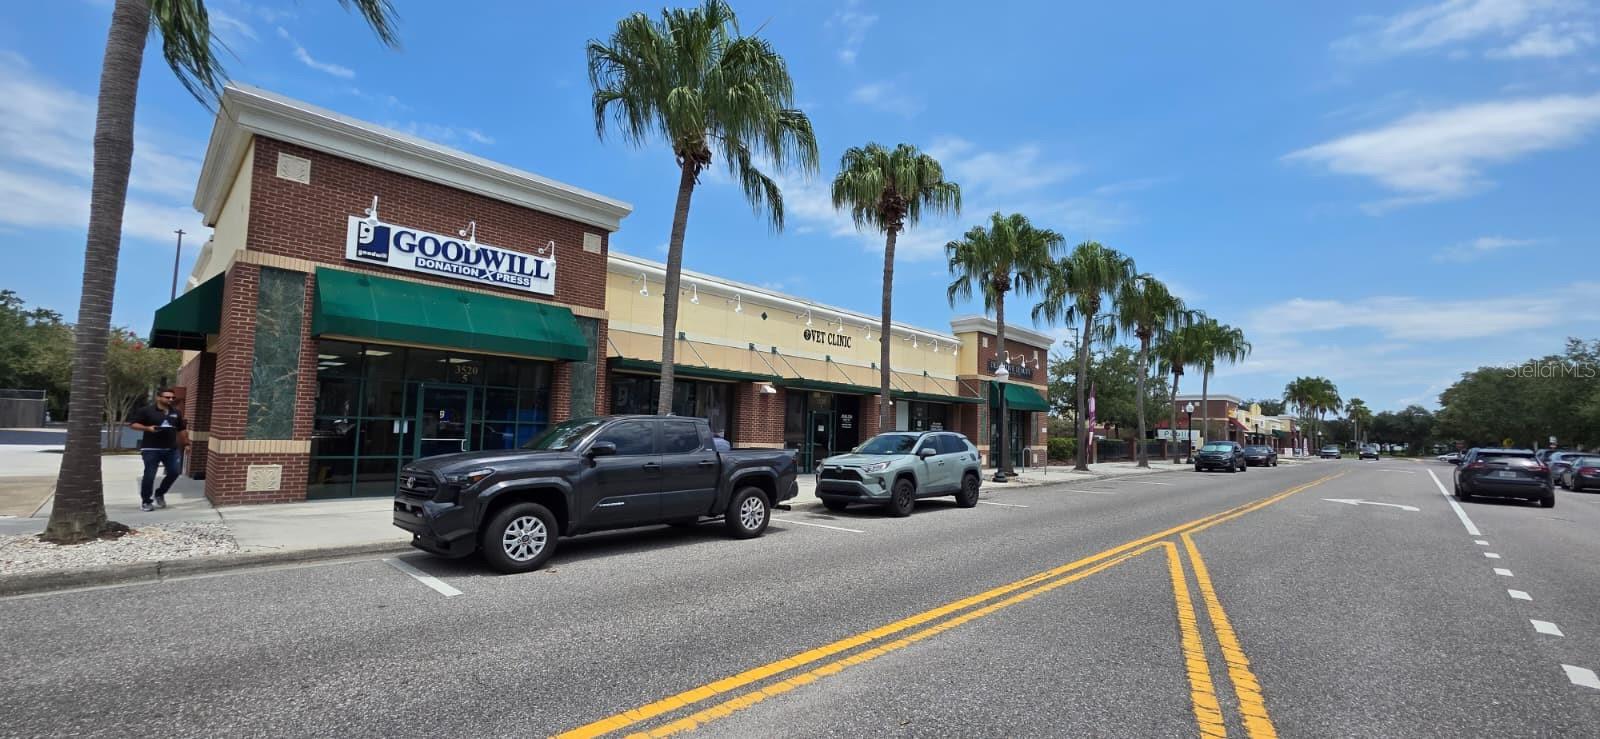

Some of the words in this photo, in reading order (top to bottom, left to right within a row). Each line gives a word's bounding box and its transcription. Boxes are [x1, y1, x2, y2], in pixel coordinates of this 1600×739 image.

[394, 231, 549, 279] GOODWILL
[417, 258, 479, 277] DONATION
[811, 330, 826, 343] VET
[827, 333, 852, 348] CLINIC
[455, 365, 478, 375] 3520
[461, 375, 468, 383] 5
